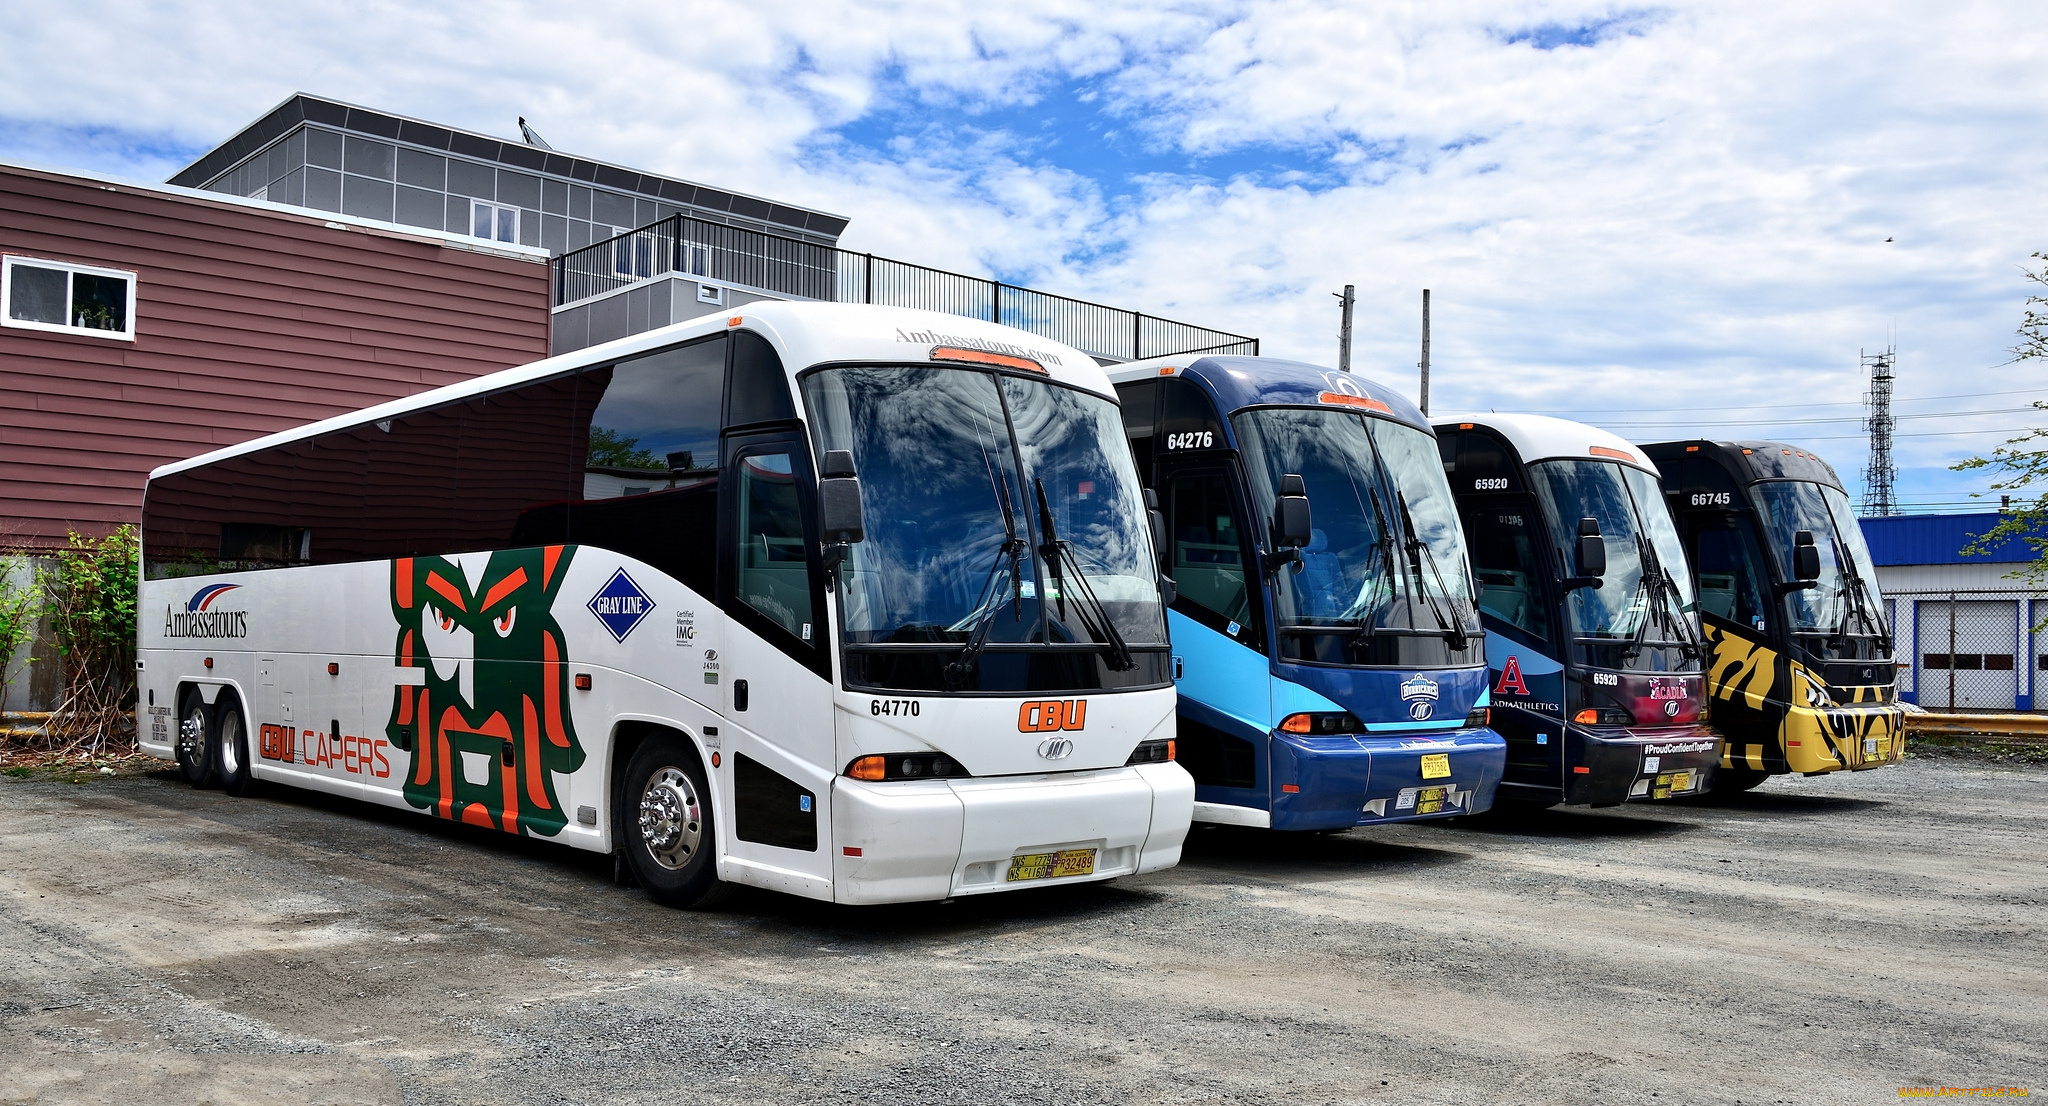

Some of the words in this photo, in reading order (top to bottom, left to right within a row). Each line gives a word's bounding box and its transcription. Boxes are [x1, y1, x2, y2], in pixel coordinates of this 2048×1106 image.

[896, 328, 1063, 366] Ambassatours.com
[1168, 431, 1213, 449] 64276
[1475, 478, 1507, 490] 65920
[1691, 492, 1730, 506] 66745
[597, 596, 621, 614] GRAY
[622, 596, 643, 614] LINE
[164, 602, 247, 638] Ambassatours
[676, 610, 694, 618] Certified
[676, 618, 694, 626] Member
[676, 626, 694, 640] IMG
[703, 662, 719, 670] J4500
[1493, 655, 1531, 695] A
[1593, 673, 1618, 686] 65920
[1655, 687, 1685, 699] ACADIA
[870, 699, 921, 717] 64770
[1017, 699, 1088, 733] CBU
[260, 722, 296, 764] CBU
[303, 730, 390, 778] CAPERS
[1644, 742, 1714, 755] #ProudConfidentTogether
[1055, 856, 1092, 870] PR32489
